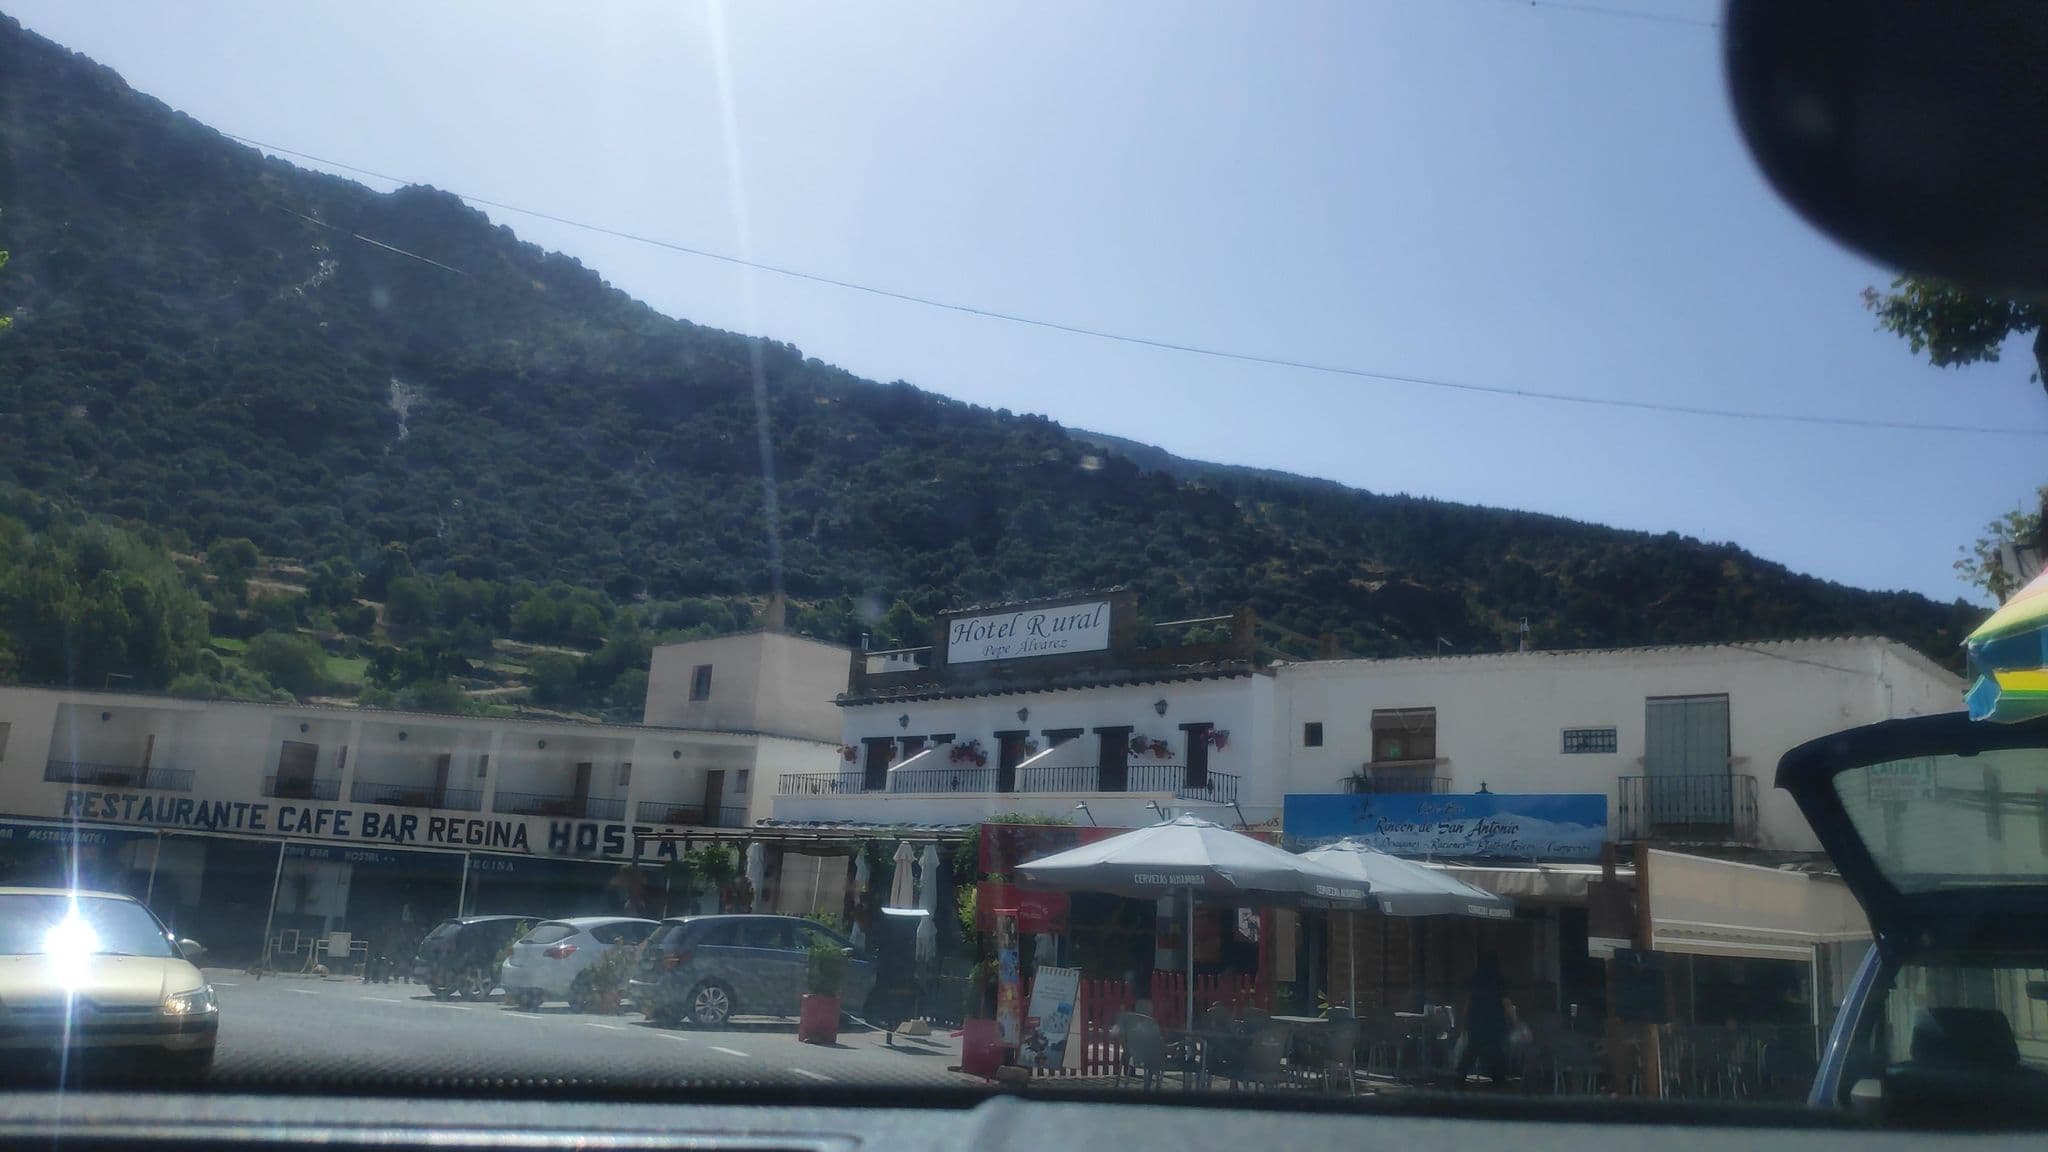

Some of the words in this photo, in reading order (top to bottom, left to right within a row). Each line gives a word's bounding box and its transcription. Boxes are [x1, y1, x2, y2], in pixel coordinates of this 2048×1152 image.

[952, 613, 1023, 645] Hotel
[1028, 602, 1109, 639] Rural
[984, 644, 1011, 658] Pepe
[64, 790, 269, 830] RESTAURANTE
[277, 805, 353, 836] CAFE
[361, 812, 418, 842] BAR
[428, 817, 529, 849] REGINA
[1417, 821, 1433, 834] de
[1438, 822, 1464, 834] San
[1467, 818, 1520, 837] Antonio
